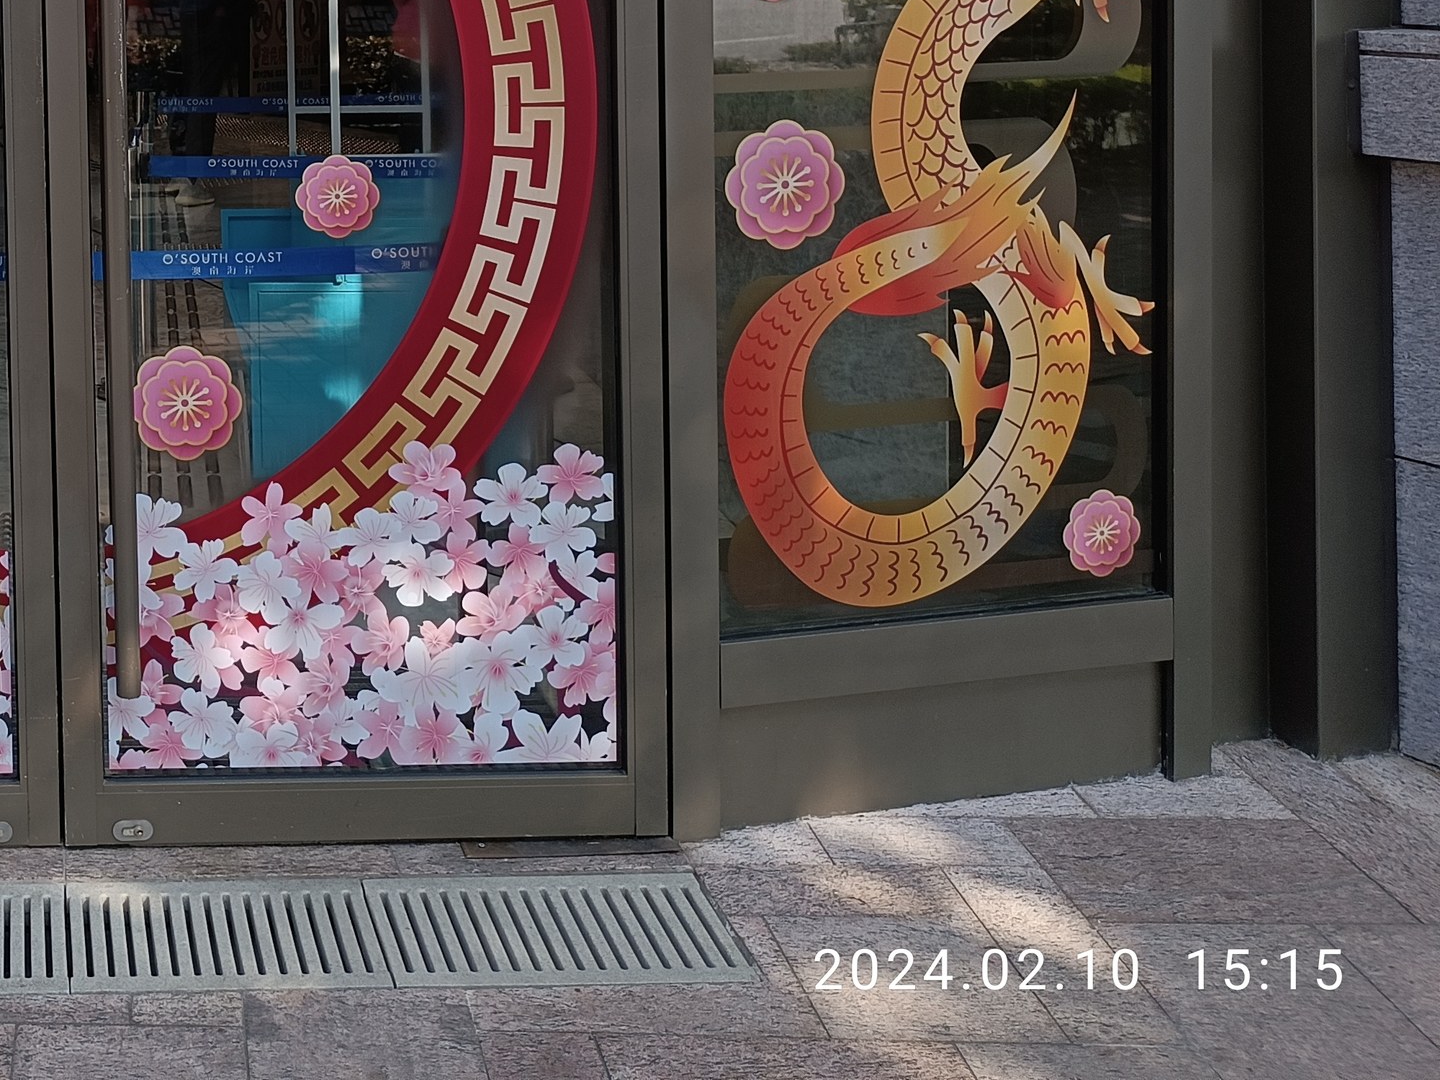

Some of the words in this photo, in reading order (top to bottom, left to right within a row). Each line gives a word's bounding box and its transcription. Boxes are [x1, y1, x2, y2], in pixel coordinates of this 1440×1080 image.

[207, 158, 258, 168] O'SOUTH
[262, 158, 299, 169] COAST
[162, 252, 228, 265] O'SOUTH
[235, 251, 283, 264] COAST
